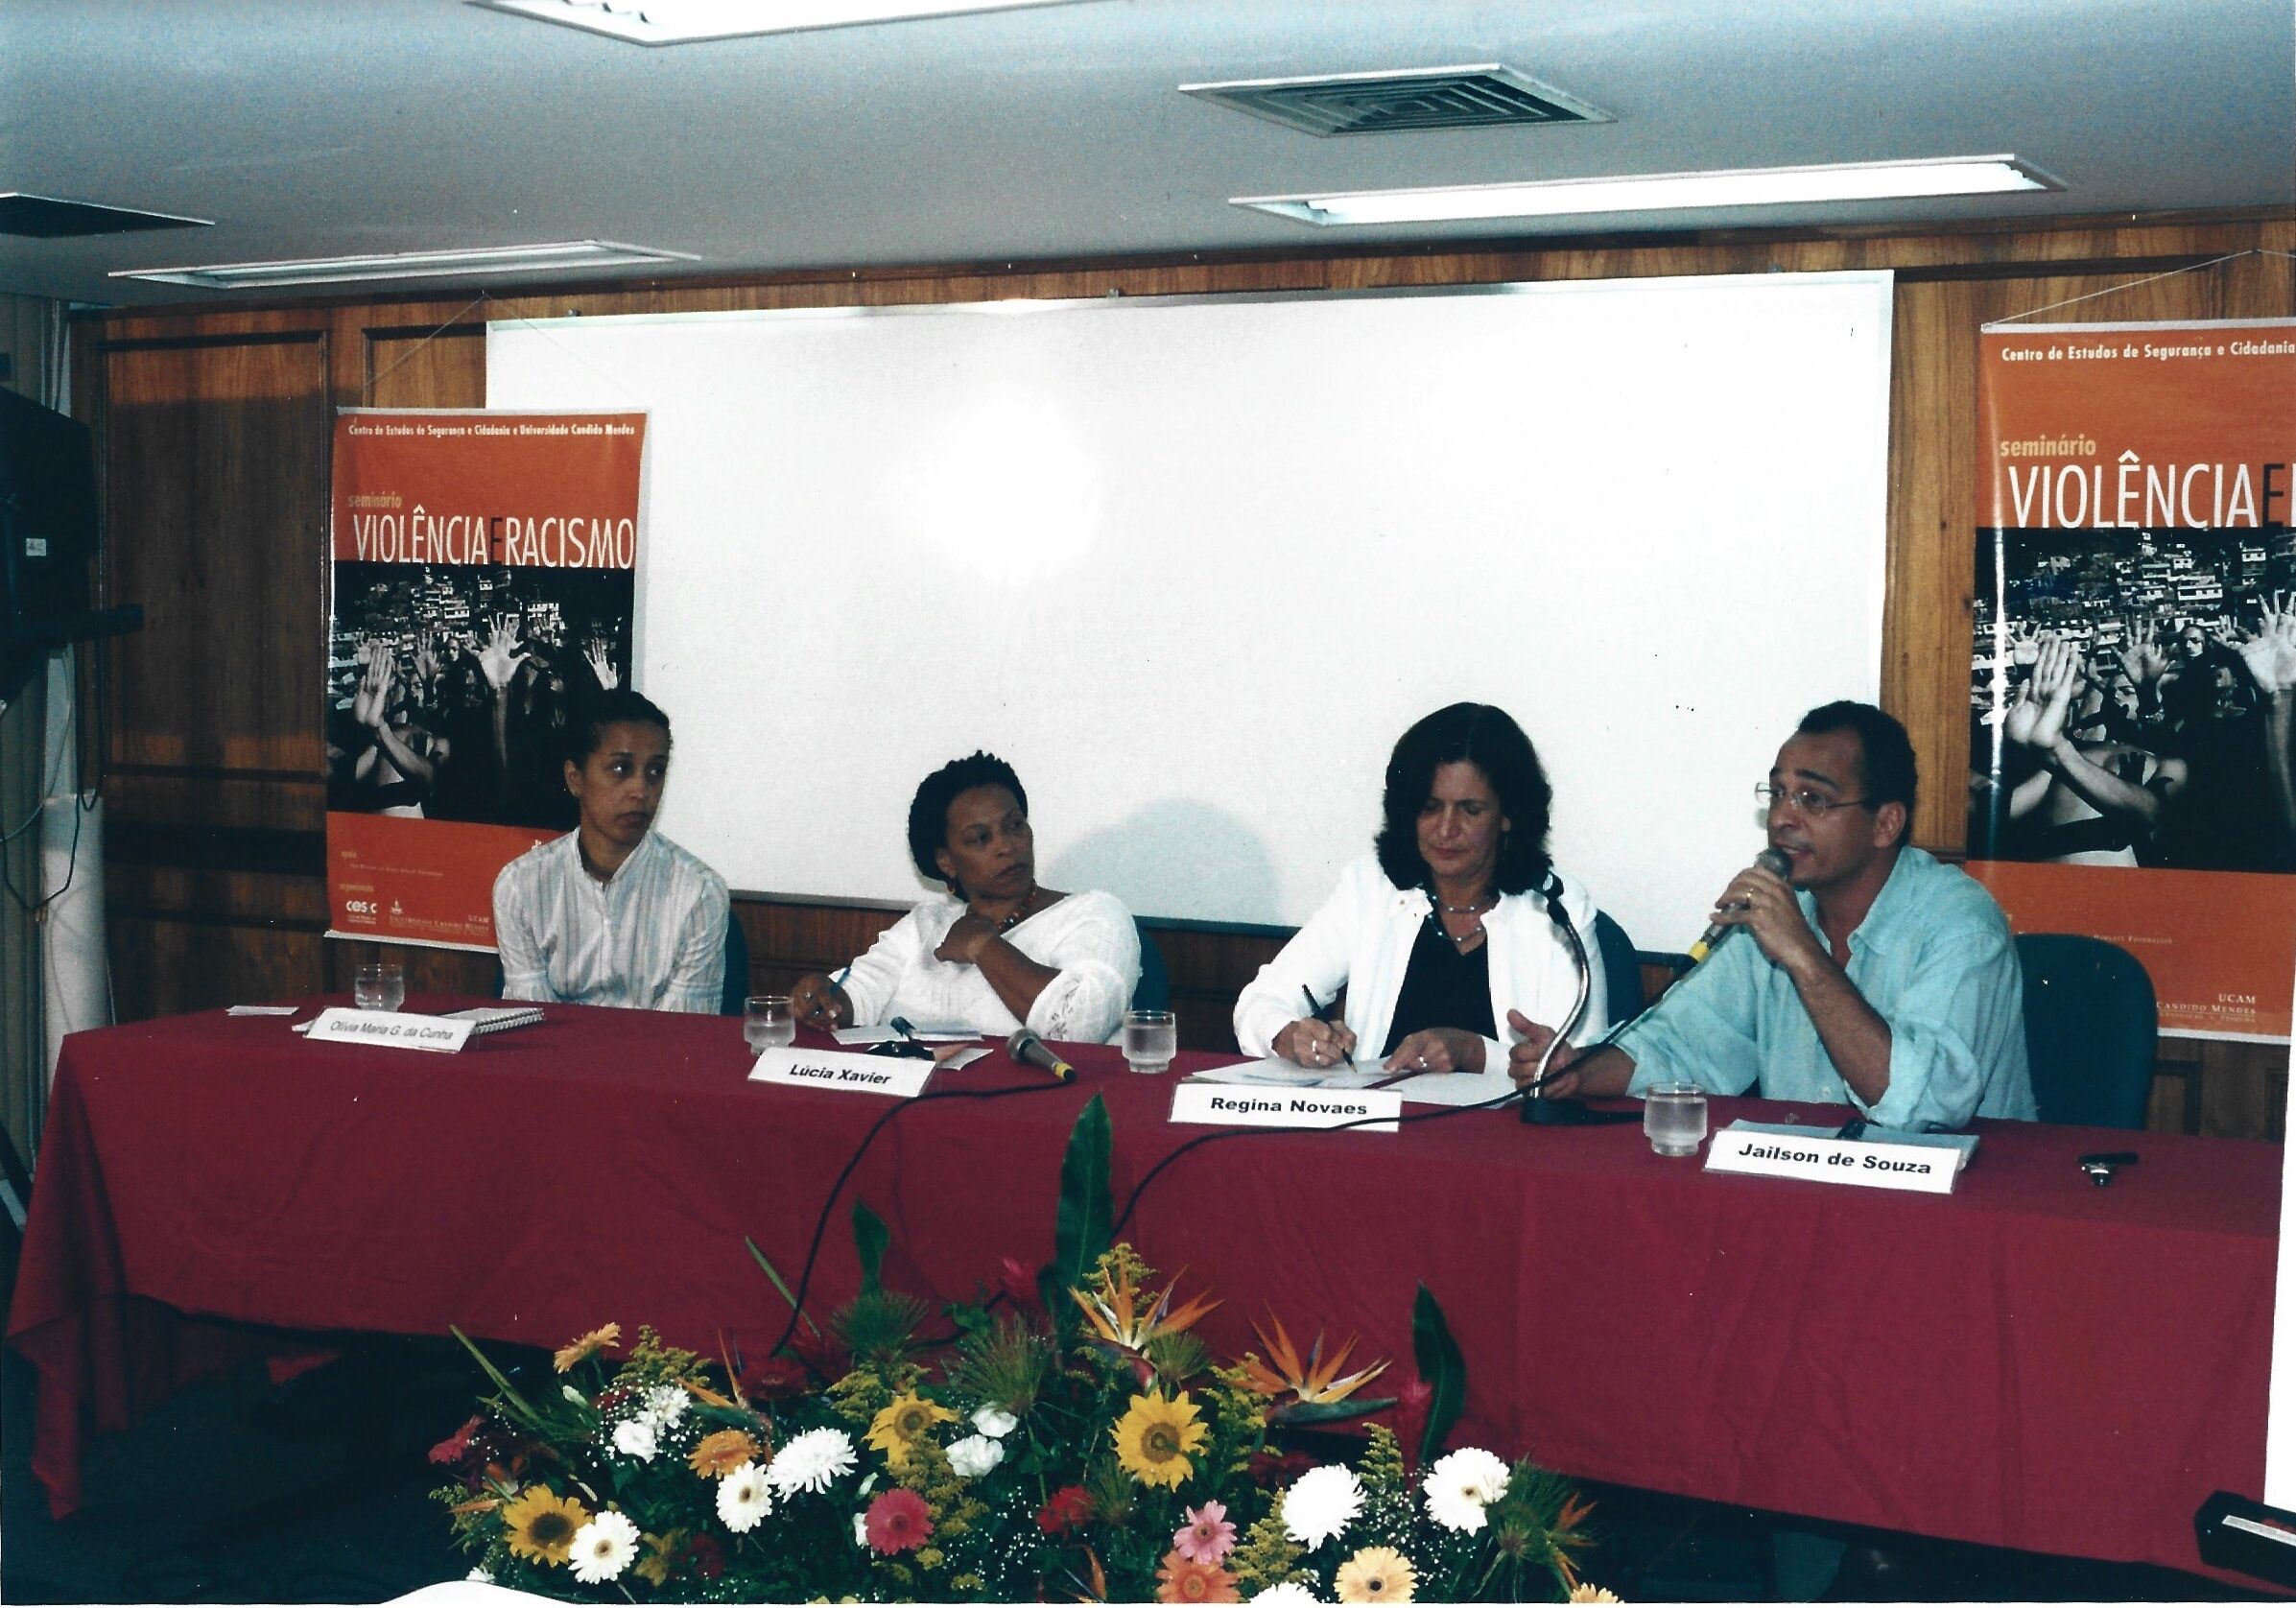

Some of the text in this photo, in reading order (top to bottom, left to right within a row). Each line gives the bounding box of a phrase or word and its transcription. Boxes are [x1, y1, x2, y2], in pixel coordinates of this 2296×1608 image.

[2001, 340, 2295, 361] Centro de Estudos de Segurança e Cidadania
[348, 424, 373, 436] Centro
[374, 424, 384, 435] de
[386, 424, 414, 436] Estudos
[416, 424, 425, 436] de
[427, 424, 465, 437] Segurança
[475, 424, 510, 436] Cidadania
[519, 424, 569, 436] Universidade
[571, 423, 603, 436] Candido
[605, 423, 635, 436] Mendes
[2000, 434, 2095, 457] seminário
[2008, 449, 2259, 529] VIOLÊNCIA
[347, 490, 403, 508] seminário
[353, 504, 489, 565] VIOLÊNCIA
[506, 517, 634, 569] RACISMO
[2156, 1001, 2256, 1014] CANDIDO MENDES
[2218, 993, 2256, 1004] UCAM
[361, 1022, 389, 1035] Maria
[404, 1027, 417, 1037] da
[419, 1028, 453, 1040] Cunha
[789, 1064, 892, 1085] Lúcia Xavier
[1210, 1097, 1367, 1115] Regina Novaes
[1739, 1143, 1931, 1174] Jailson de Souza
